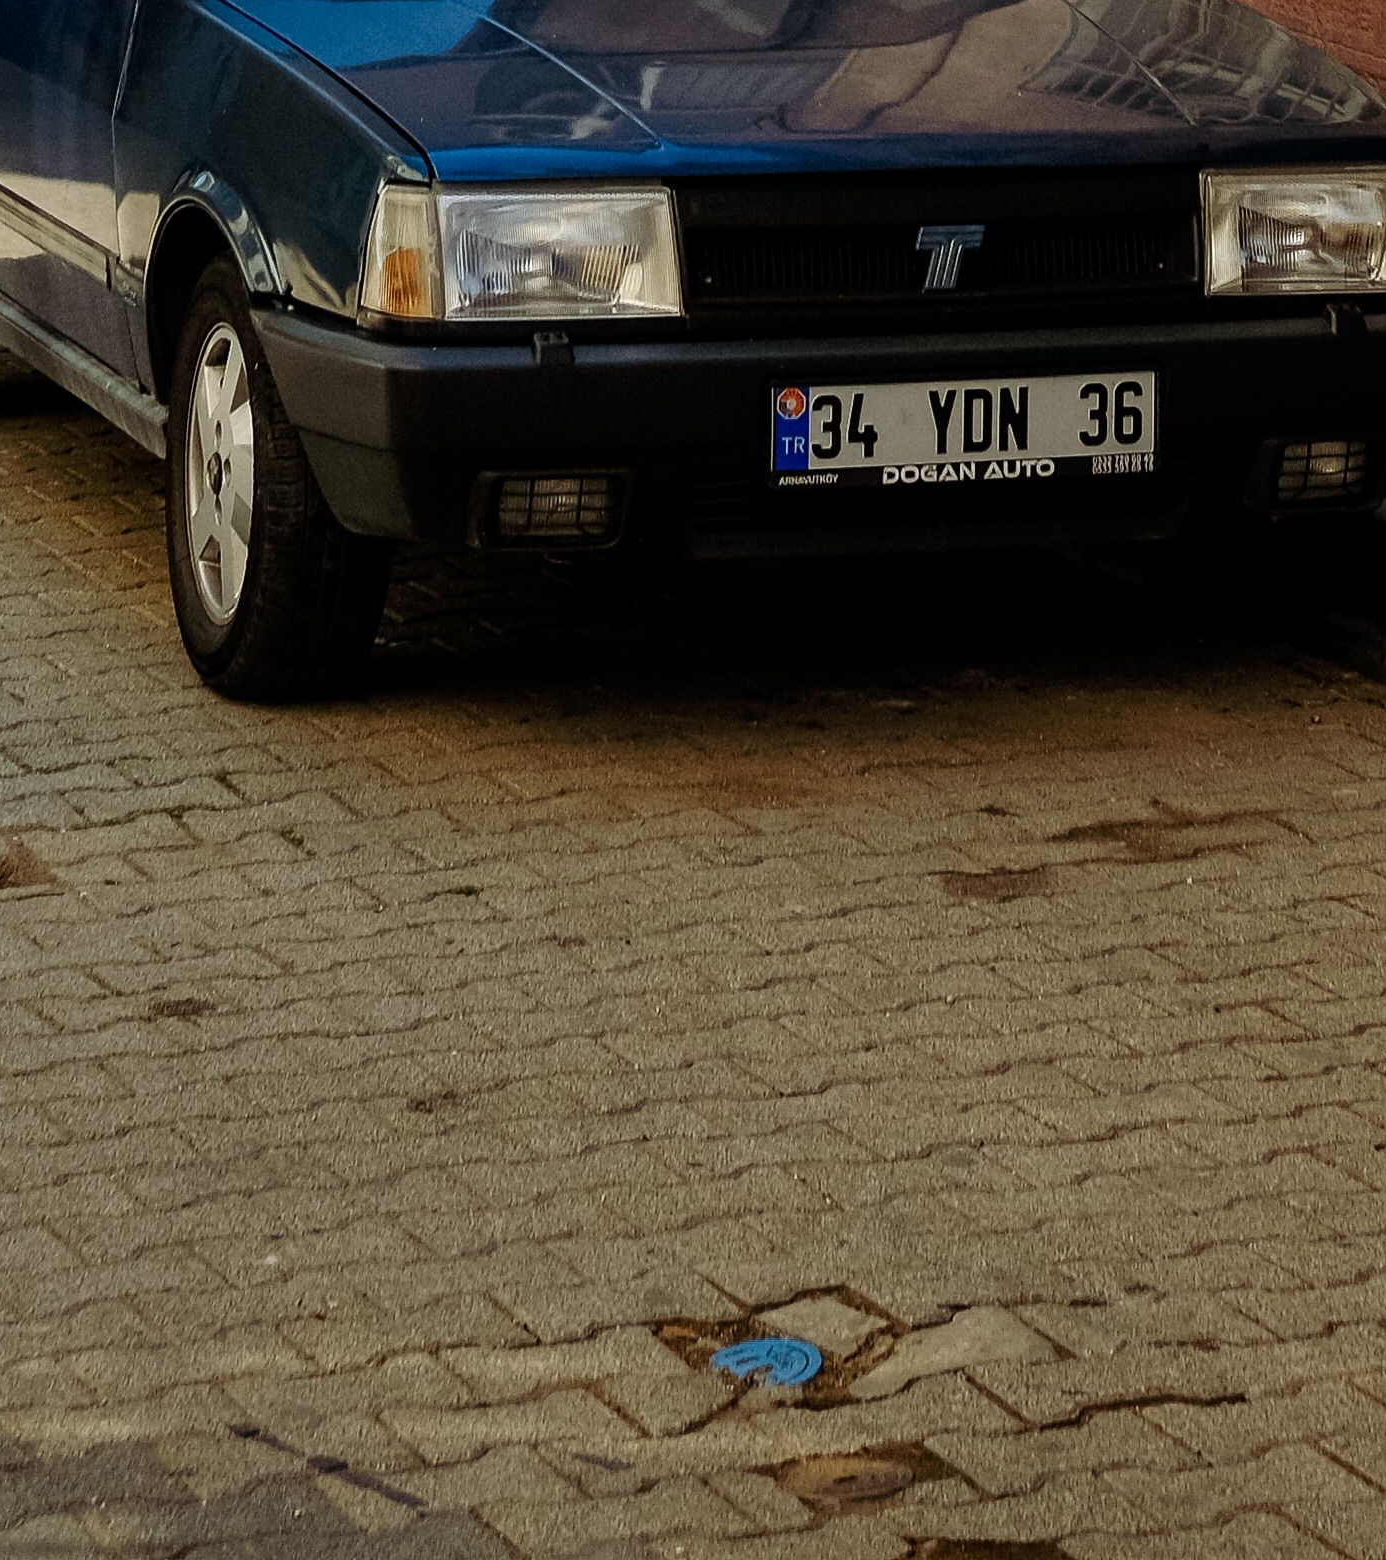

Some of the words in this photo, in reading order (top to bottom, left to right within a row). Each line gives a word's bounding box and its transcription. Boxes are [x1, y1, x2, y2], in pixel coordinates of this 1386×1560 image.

[811, 393, 879, 459] 34
[928, 386, 1029, 454] YDN
[1079, 381, 1144, 447] 36
[782, 436, 806, 456] TR
[881, 461, 977, 486] DOGAN
[983, 458, 1056, 480] AUTO
